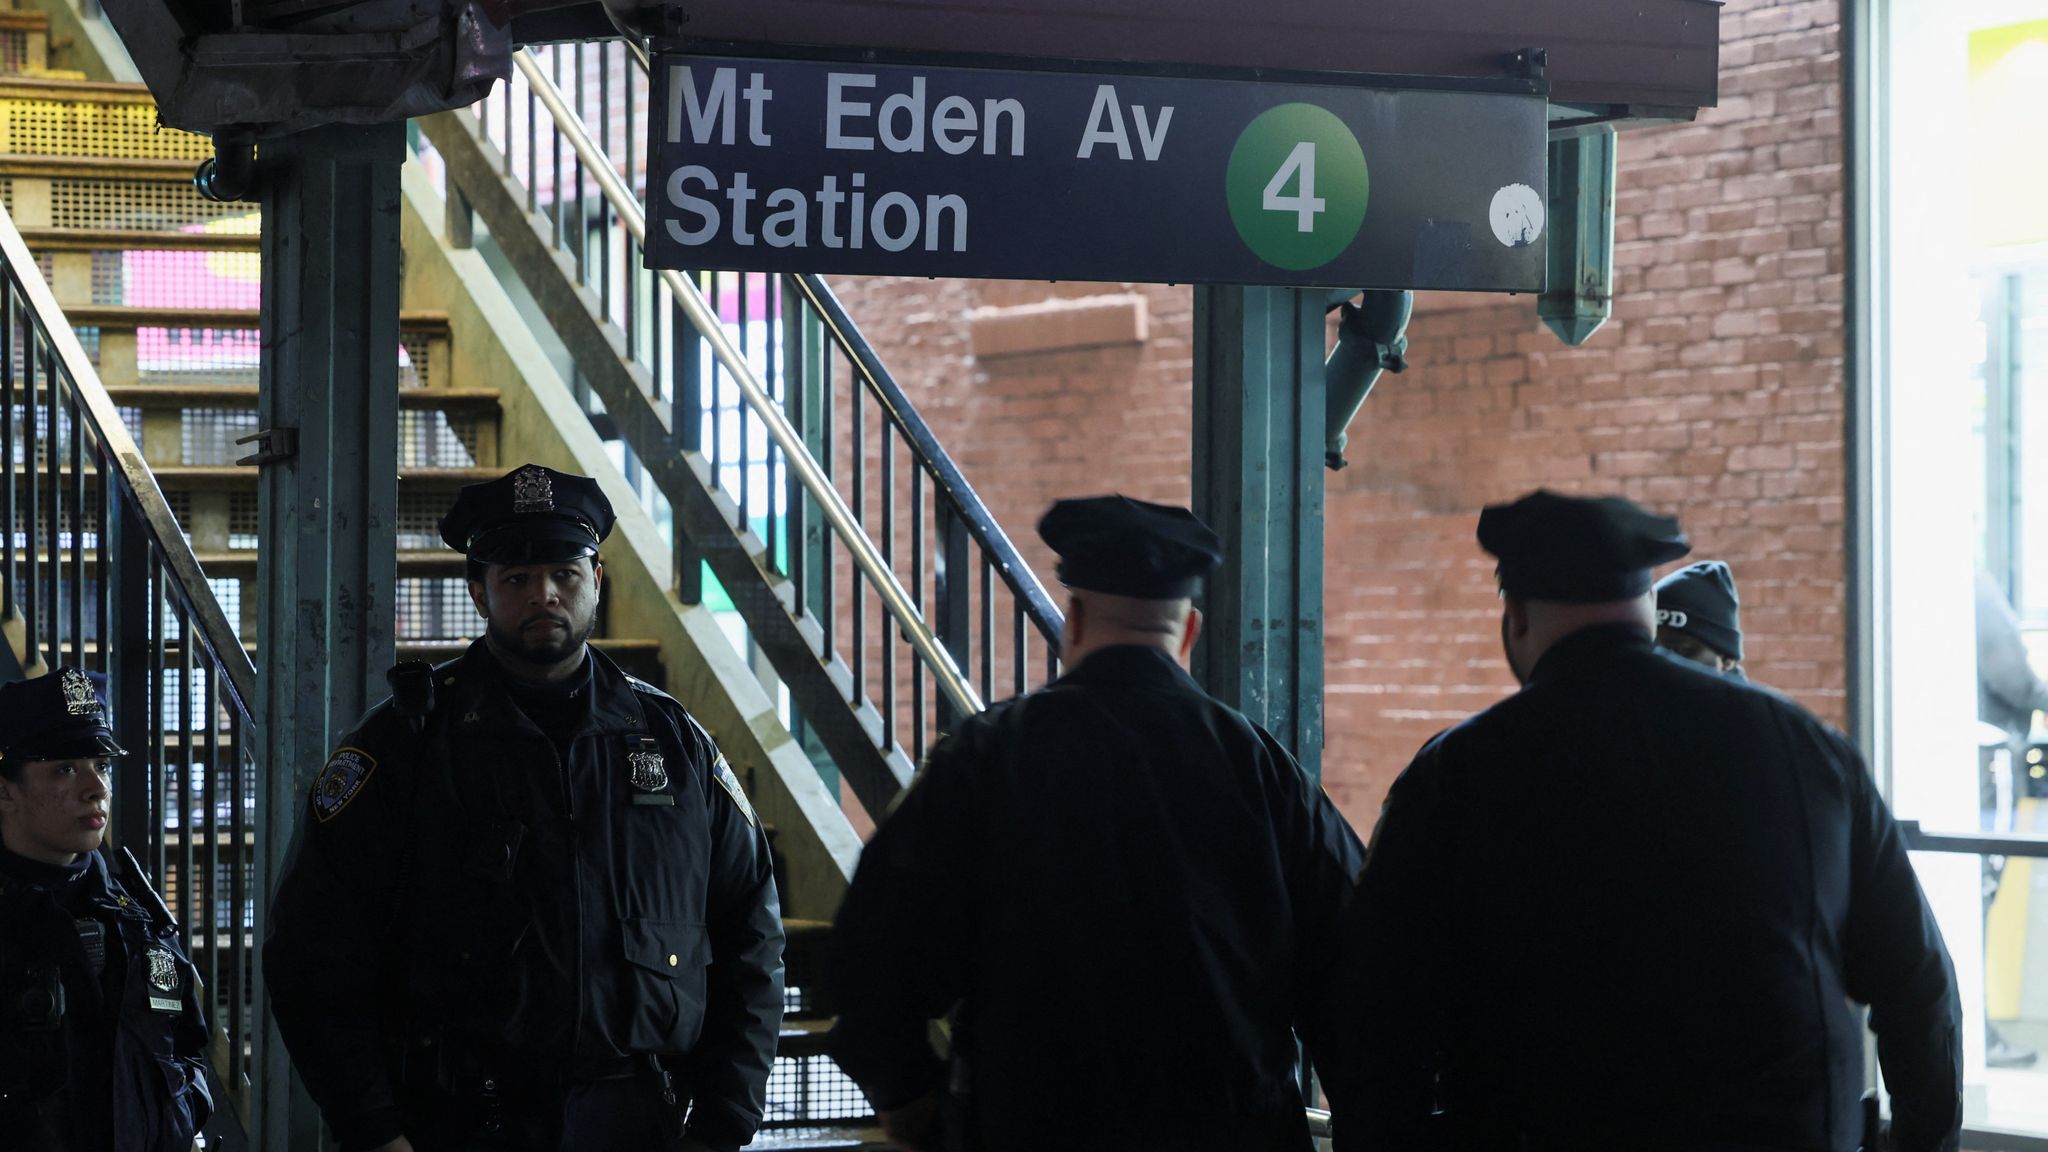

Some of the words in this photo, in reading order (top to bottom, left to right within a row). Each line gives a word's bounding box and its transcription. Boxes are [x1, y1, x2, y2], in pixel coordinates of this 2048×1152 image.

[666, 65, 773, 147] Mt
[826, 72, 1026, 156] Eden
[1076, 84, 1175, 161] Av
[665, 165, 968, 252] Station
[1262, 141, 1326, 233] 4
[328, 799, 344, 814] NEW
[343, 779, 362, 800] YORK
[338, 751, 361, 763] POLICE
